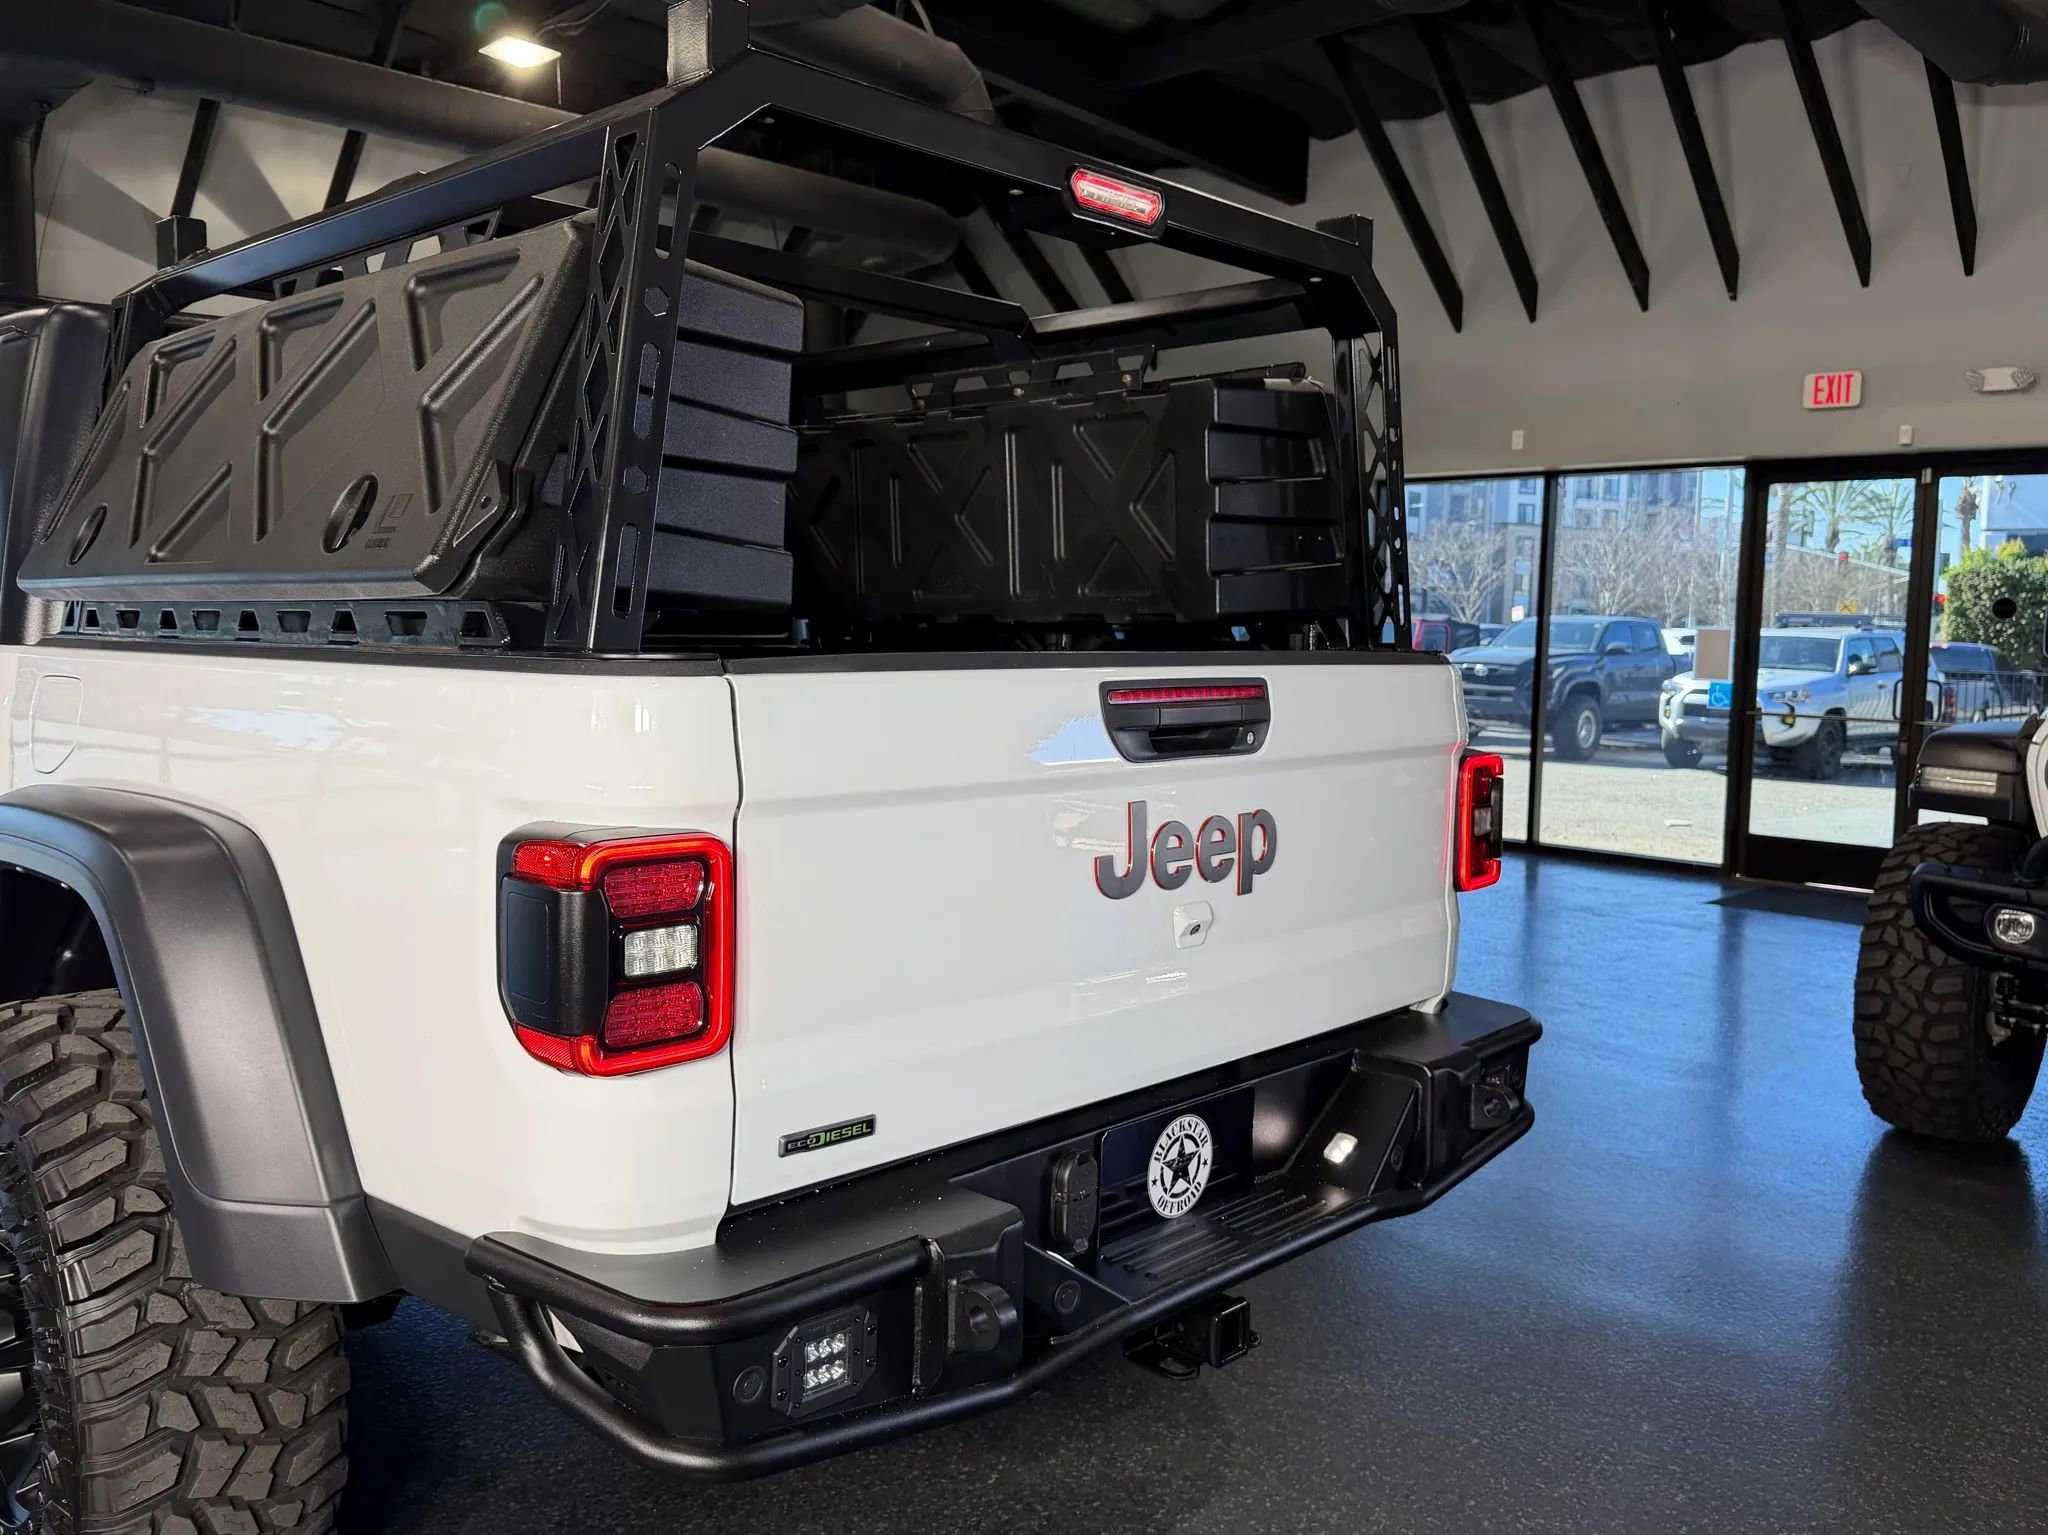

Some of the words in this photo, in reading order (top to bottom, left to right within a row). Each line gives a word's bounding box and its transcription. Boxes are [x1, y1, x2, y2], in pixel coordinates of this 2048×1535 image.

[1813, 374, 1855, 405] EXIT
[1094, 800, 1277, 900] Jeep
[1153, 1119, 1208, 1162] BLACKSTAR
[1157, 1182, 1202, 1213] OFFROAD
